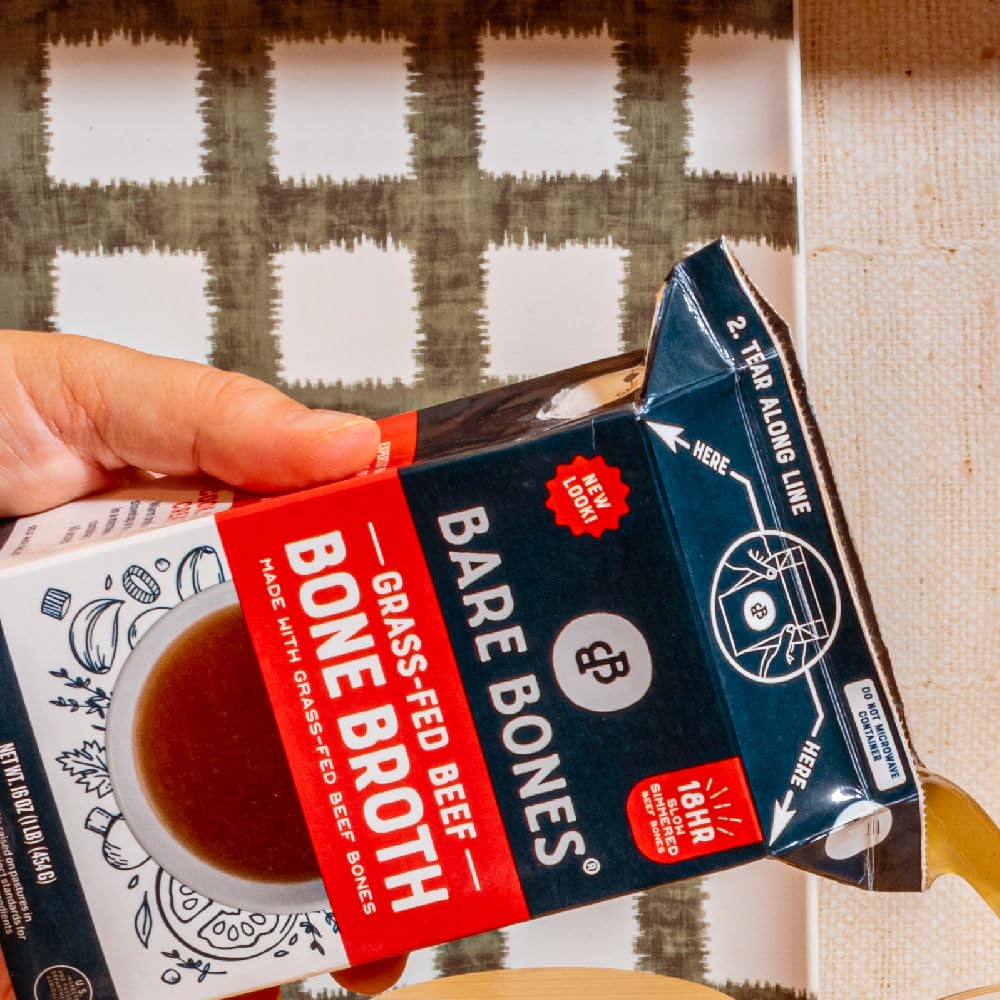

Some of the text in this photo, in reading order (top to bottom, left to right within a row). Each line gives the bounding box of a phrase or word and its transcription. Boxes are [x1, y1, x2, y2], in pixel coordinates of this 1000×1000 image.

[726, 315, 812, 516] 2. TEAR ALONG LINE
[693, 440, 730, 476] HERE
[562, 476, 598, 524] LOOK!
[581, 472, 612, 509] NEW
[437, 505, 528, 663] BARE
[284, 530, 450, 913] BONE BROTH
[372, 571, 478, 840] GRASS-FED BEEF
[0, 742, 20, 765] NET
[259, 557, 376, 916] MADE WITH GRASS-FED BEEF BONES
[858, 710, 882, 762] CONTAINER
[861, 686, 900, 780] DO NOT MICROWAVE
[4, 764, 25, 786] WT.
[790, 740, 821, 790] HERE
[10, 785, 30, 799] 16
[14, 798, 34, 814] OZ
[677, 780, 716, 845] 18HR
[22, 824, 45, 845] LB)
[641, 790, 666, 854] BEEF BONES
[650, 783, 678, 856] SIMMERED
[666, 798, 686, 836] SLOW
[6, 858, 16, 870] on
[27, 846, 52, 872] (454
[8, 870, 29, 912] pastures
